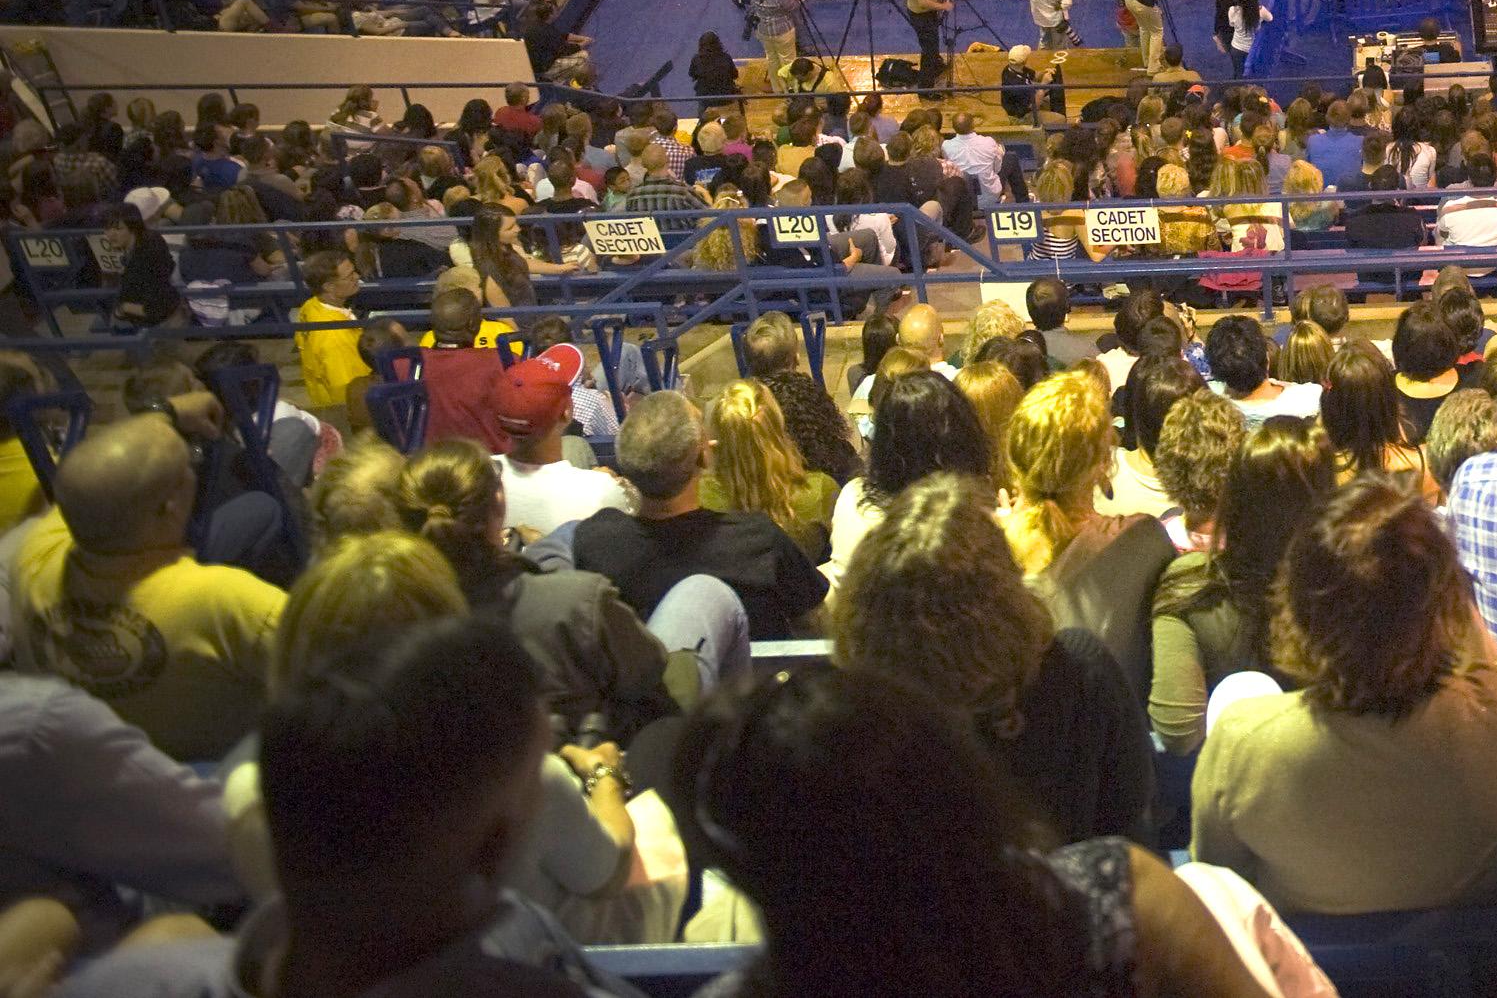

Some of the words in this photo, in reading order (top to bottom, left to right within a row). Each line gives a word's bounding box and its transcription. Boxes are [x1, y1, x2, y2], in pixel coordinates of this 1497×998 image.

[776, 215, 814, 233] L20
[995, 211, 1033, 230] L19
[1097, 210, 1146, 225] CADET
[596, 221, 645, 236] CADET
[1091, 227, 1156, 242] SECTION
[23, 238, 63, 258] L20
[595, 237, 661, 252] SECTION
